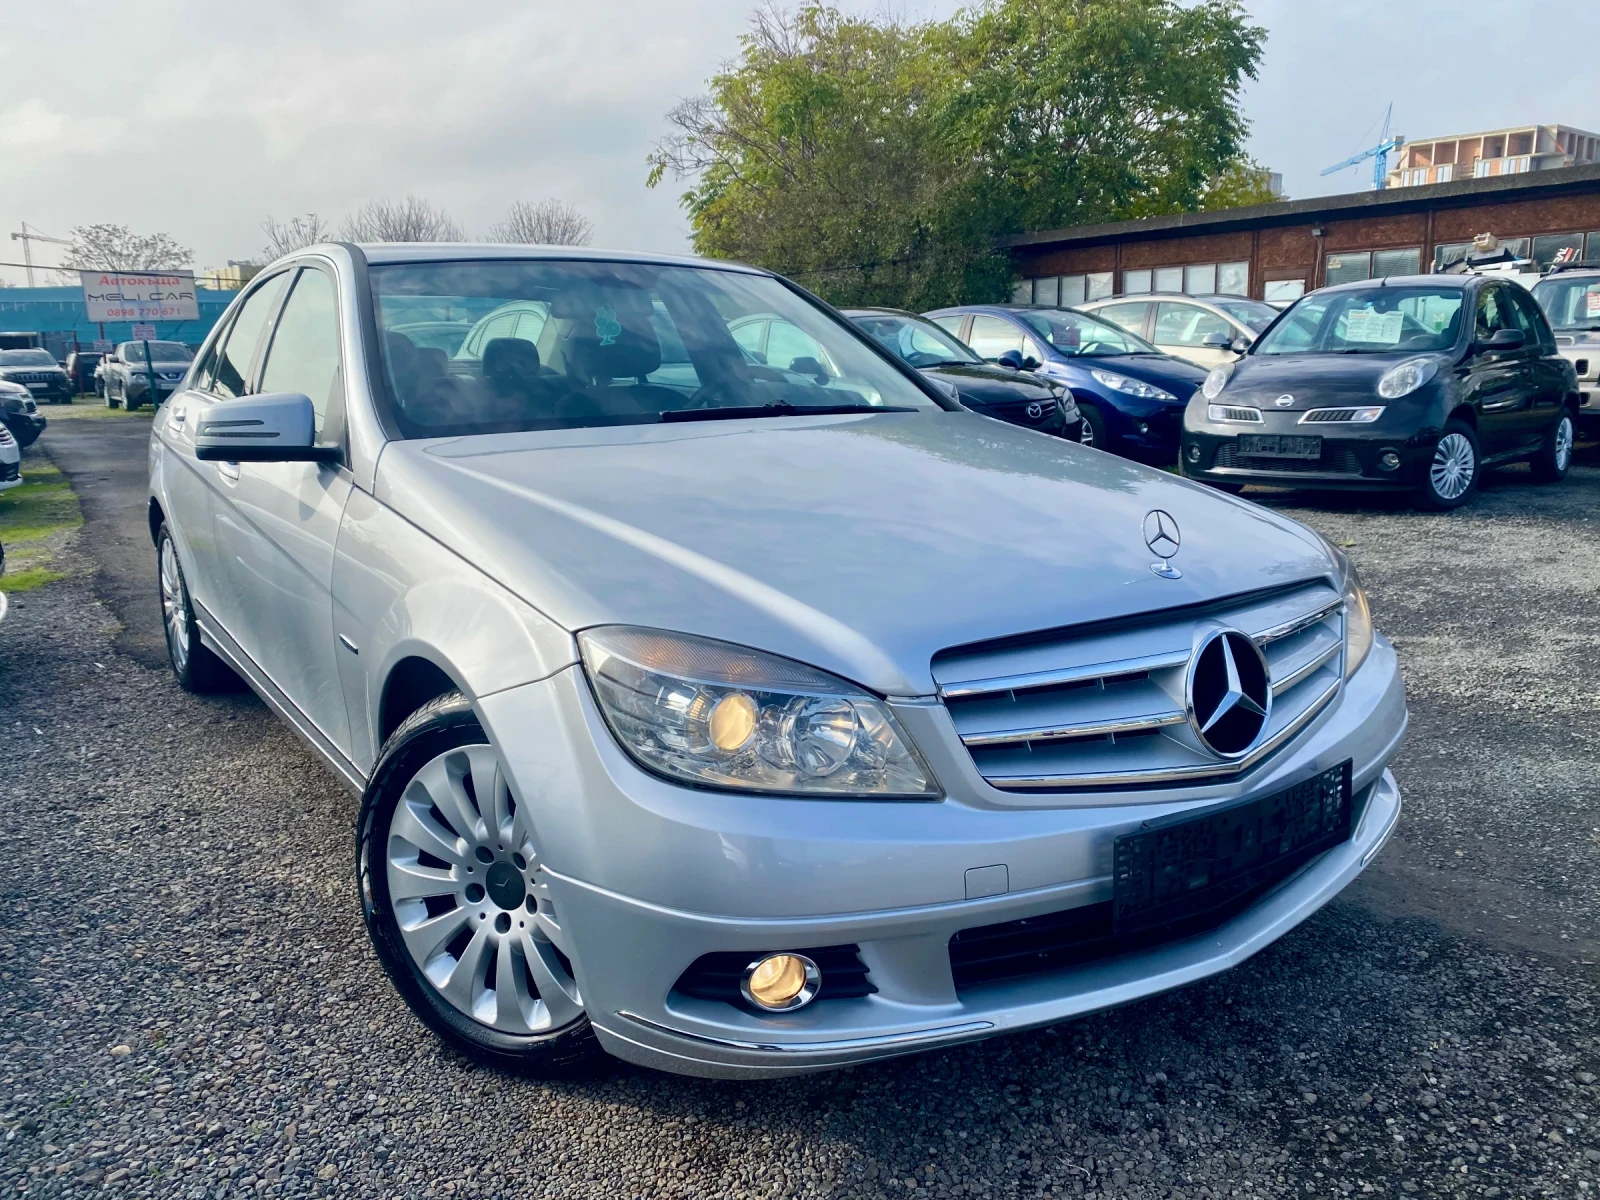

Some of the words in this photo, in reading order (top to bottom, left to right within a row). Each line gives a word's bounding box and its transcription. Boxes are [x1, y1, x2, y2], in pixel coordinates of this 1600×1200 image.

[99, 275, 180, 286] Автокъща
[88, 293, 141, 301] MELI
[149, 292, 194, 300] CAR
[107, 308, 135, 316] 0898
[139, 308, 158, 316] 770
